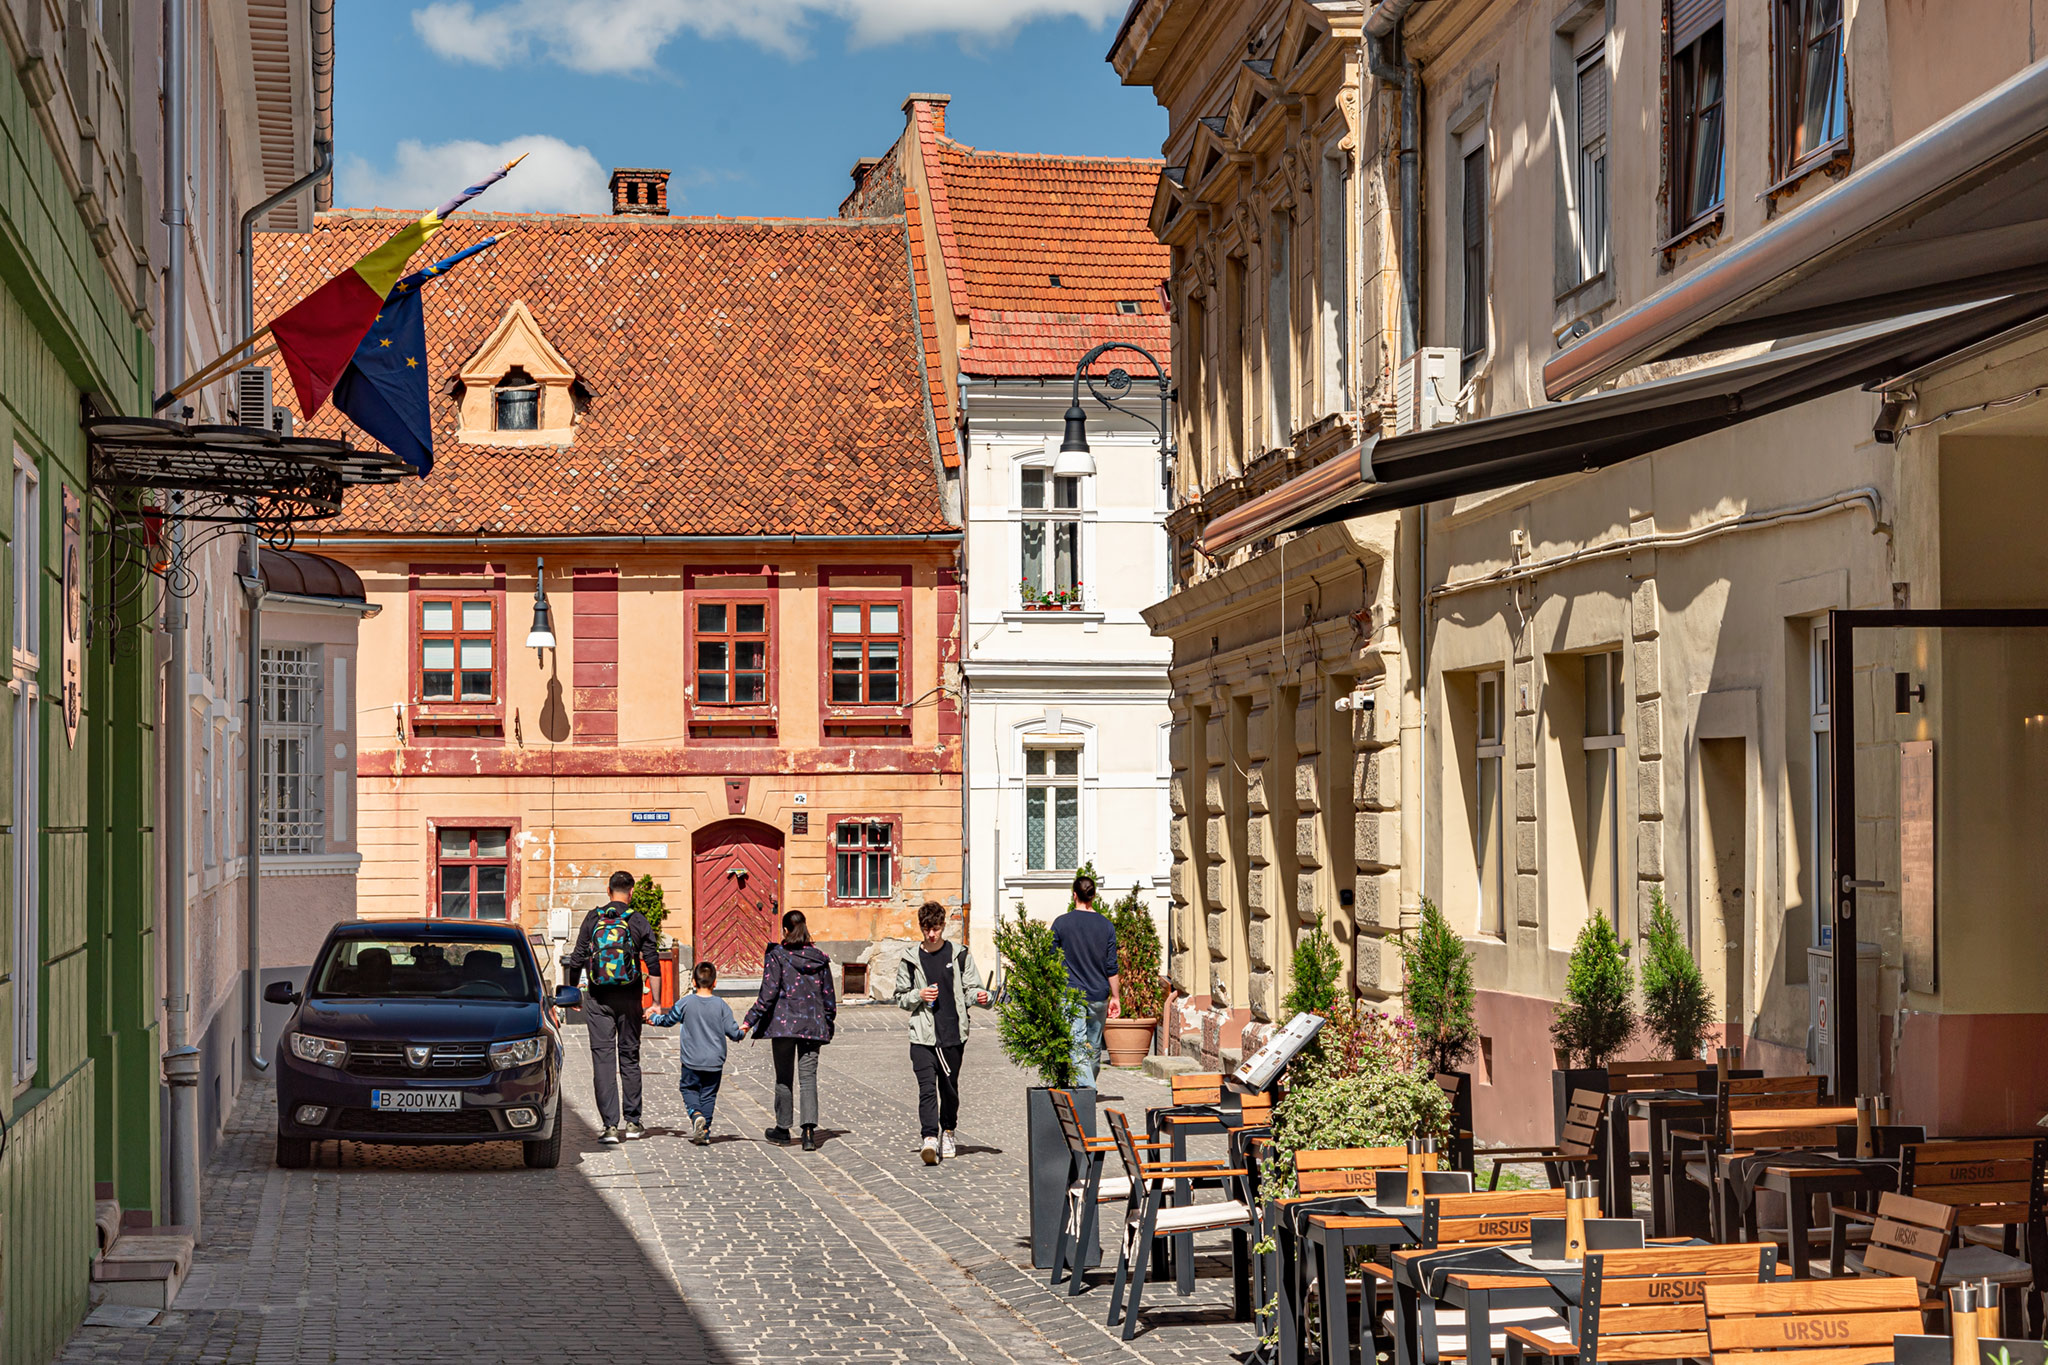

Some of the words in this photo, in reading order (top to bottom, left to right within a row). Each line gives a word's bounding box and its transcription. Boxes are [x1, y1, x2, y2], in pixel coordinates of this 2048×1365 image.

[381, 1093, 391, 1107] B
[397, 1093, 423, 1107] 200
[426, 1093, 457, 1107] WXA
[1950, 1166, 1995, 1180] URSUS
[1479, 1220, 1528, 1236] URSUS
[1894, 1226, 1918, 1246] URSUS
[1648, 1280, 1707, 1299] URSUS
[1783, 1319, 1850, 1342] URSUS
